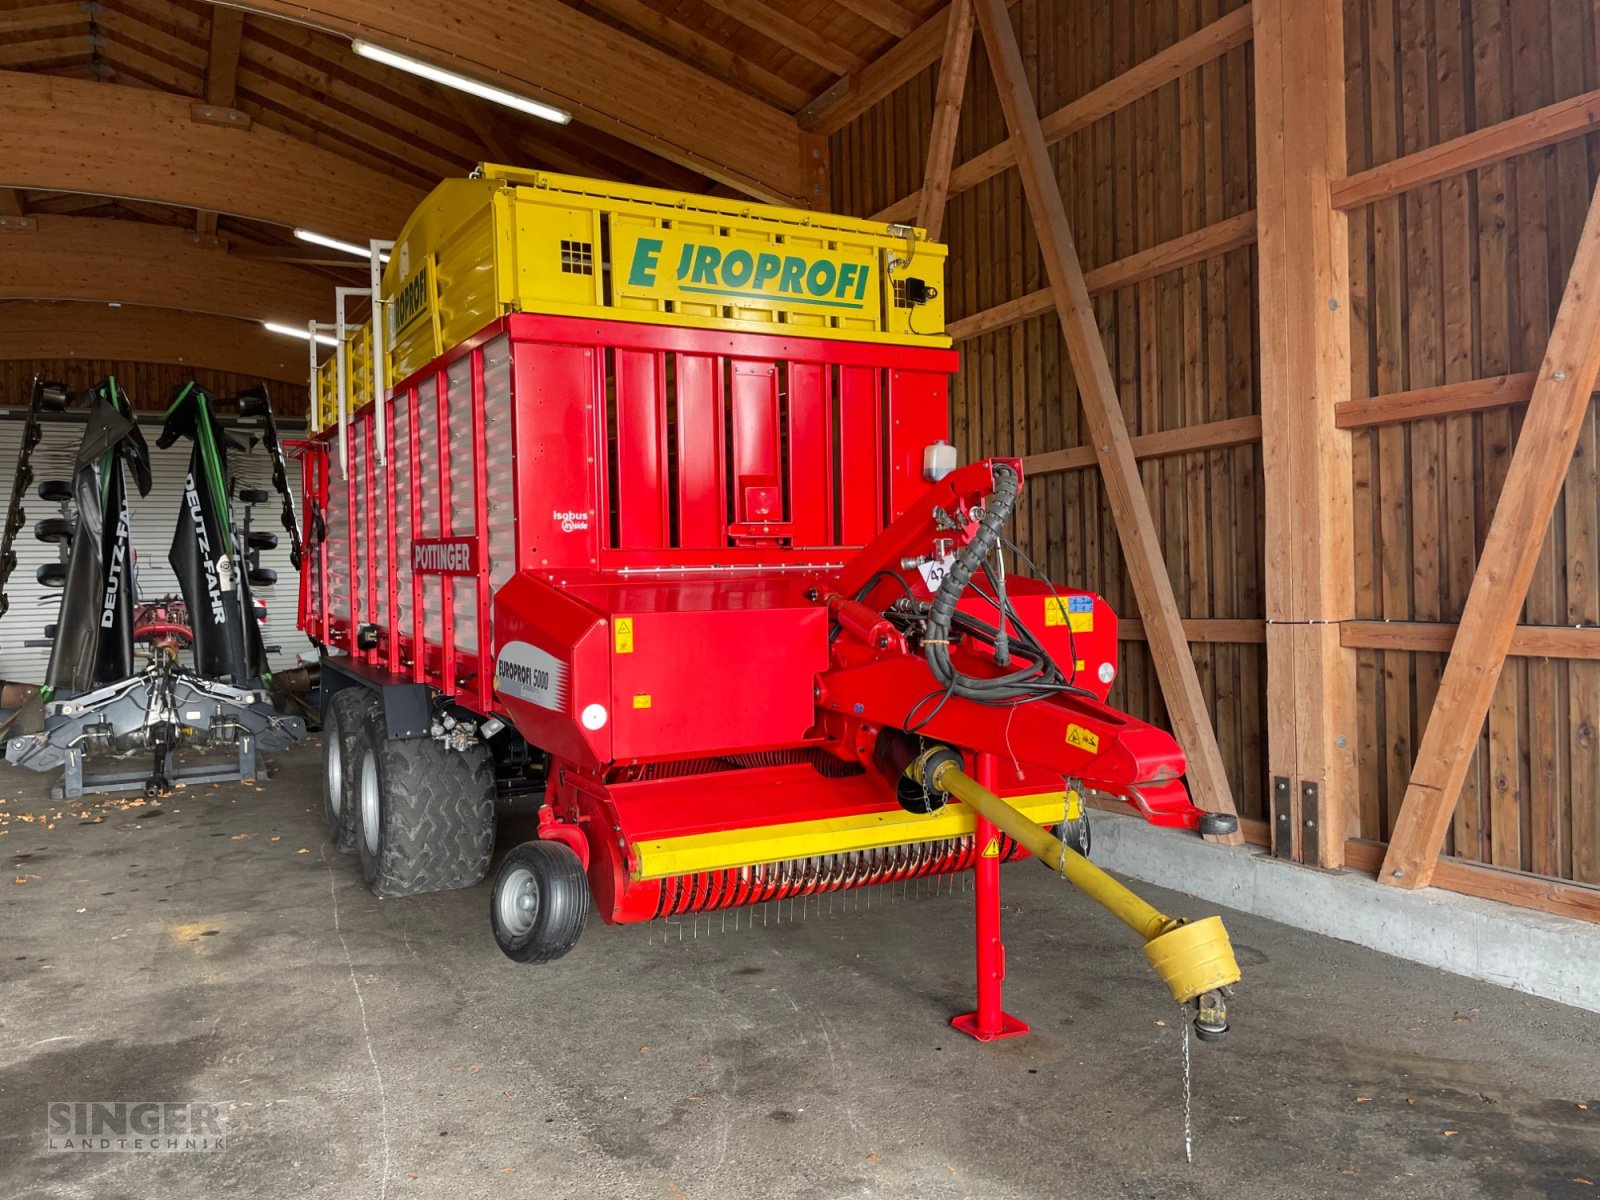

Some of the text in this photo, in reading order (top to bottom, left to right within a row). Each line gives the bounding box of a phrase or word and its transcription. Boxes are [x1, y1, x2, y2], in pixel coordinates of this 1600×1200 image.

[395, 267, 427, 330] ROPROFI
[553, 510, 588, 520] Isobus
[101, 499, 129, 629] DEUTZ-FA
[184, 472, 226, 625] DEUTZ-FAHR
[498, 659, 549, 690] EUROPROFI 5000
